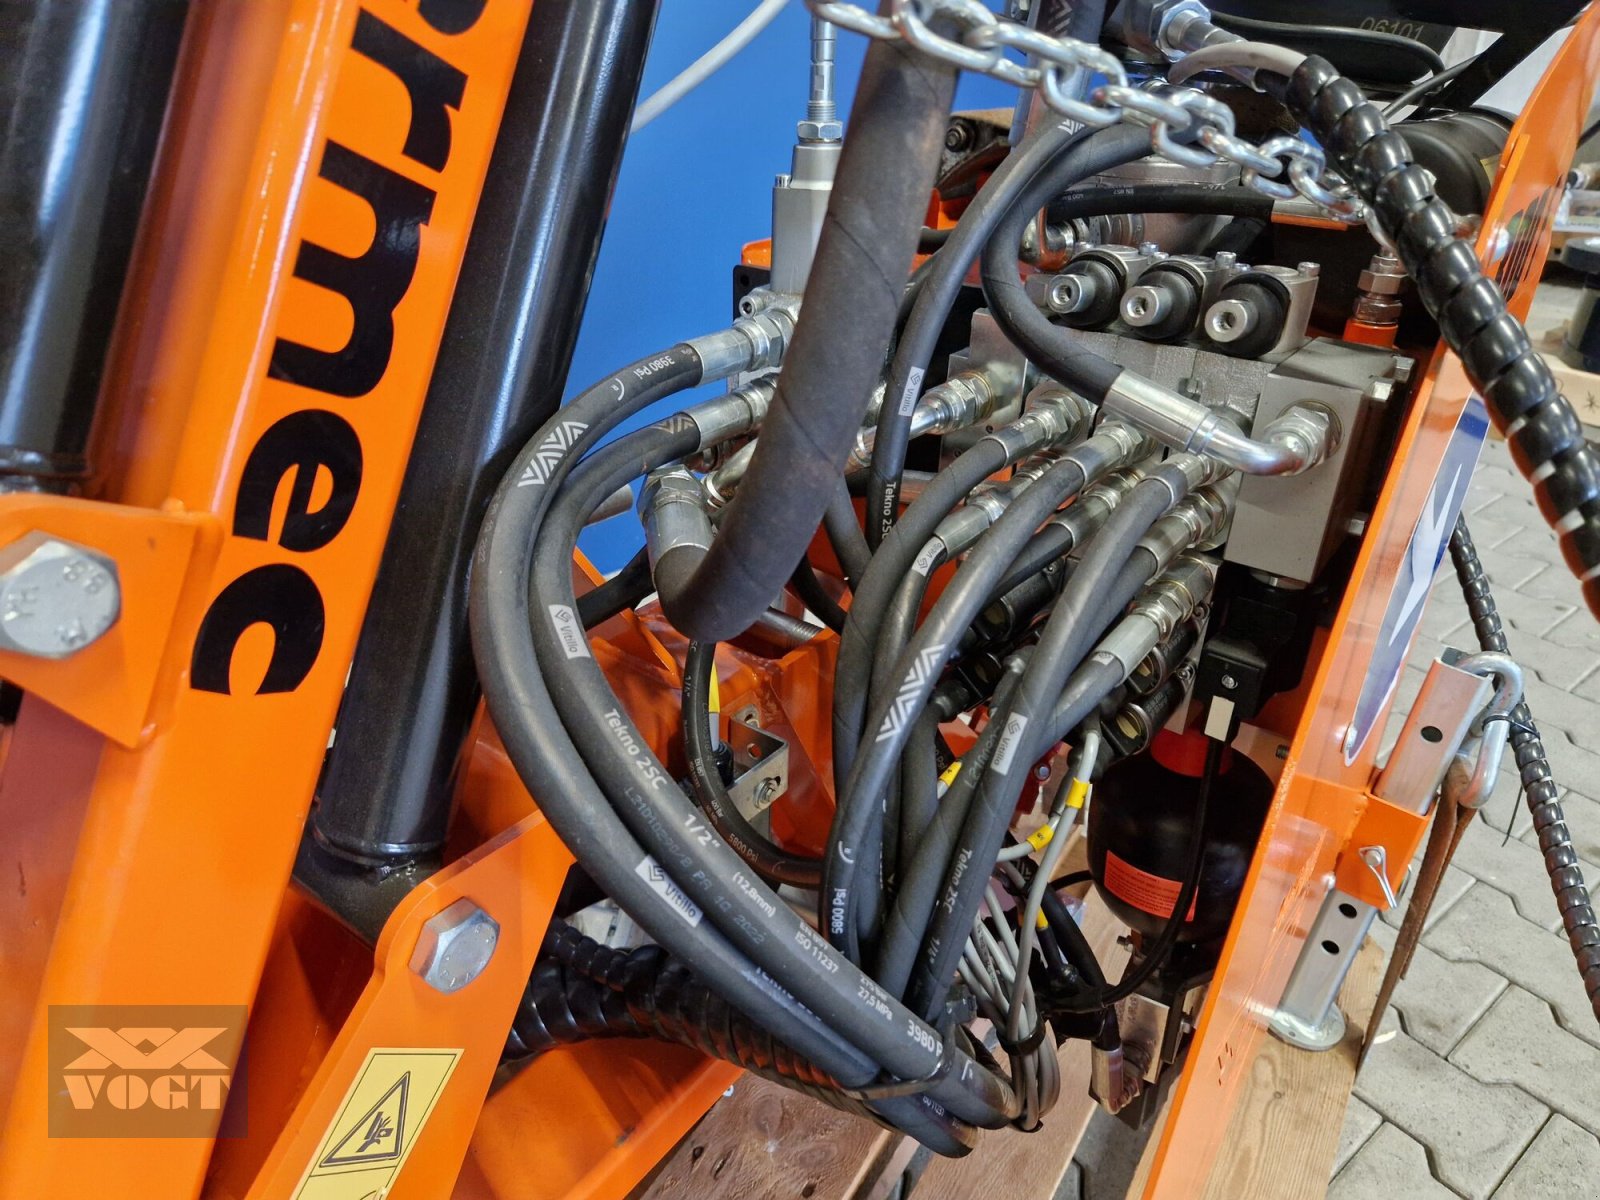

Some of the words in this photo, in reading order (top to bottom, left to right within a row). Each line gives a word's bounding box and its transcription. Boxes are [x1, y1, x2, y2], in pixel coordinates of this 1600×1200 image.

[633, 364, 653, 381] Psi
[649, 355, 676, 372] 3980
[901, 387, 916, 413] Vitillo
[884, 481, 897, 517] Tekno
[560, 625, 579, 654] Vitillo
[603, 707, 641, 757] Tekno
[635, 756, 669, 791] 2SC
[993, 736, 1012, 767] Vitillo
[728, 832, 747, 857] 5800
[746, 847, 760, 863] Psi
[952, 847, 973, 887] Tekno
[664, 882, 697, 919] Vitillo
[731, 870, 777, 919] (12,8mm)
[832, 887, 848, 906] Psi
[942, 888, 960, 914] 2SC
[831, 907, 845, 935] 5800
[793, 931, 812, 950] ISO
[811, 947, 840, 975] 11237
[857, 984, 877, 1007] 27,5
[874, 1002, 893, 1022] MPa
[906, 1019, 935, 1051] 3980
